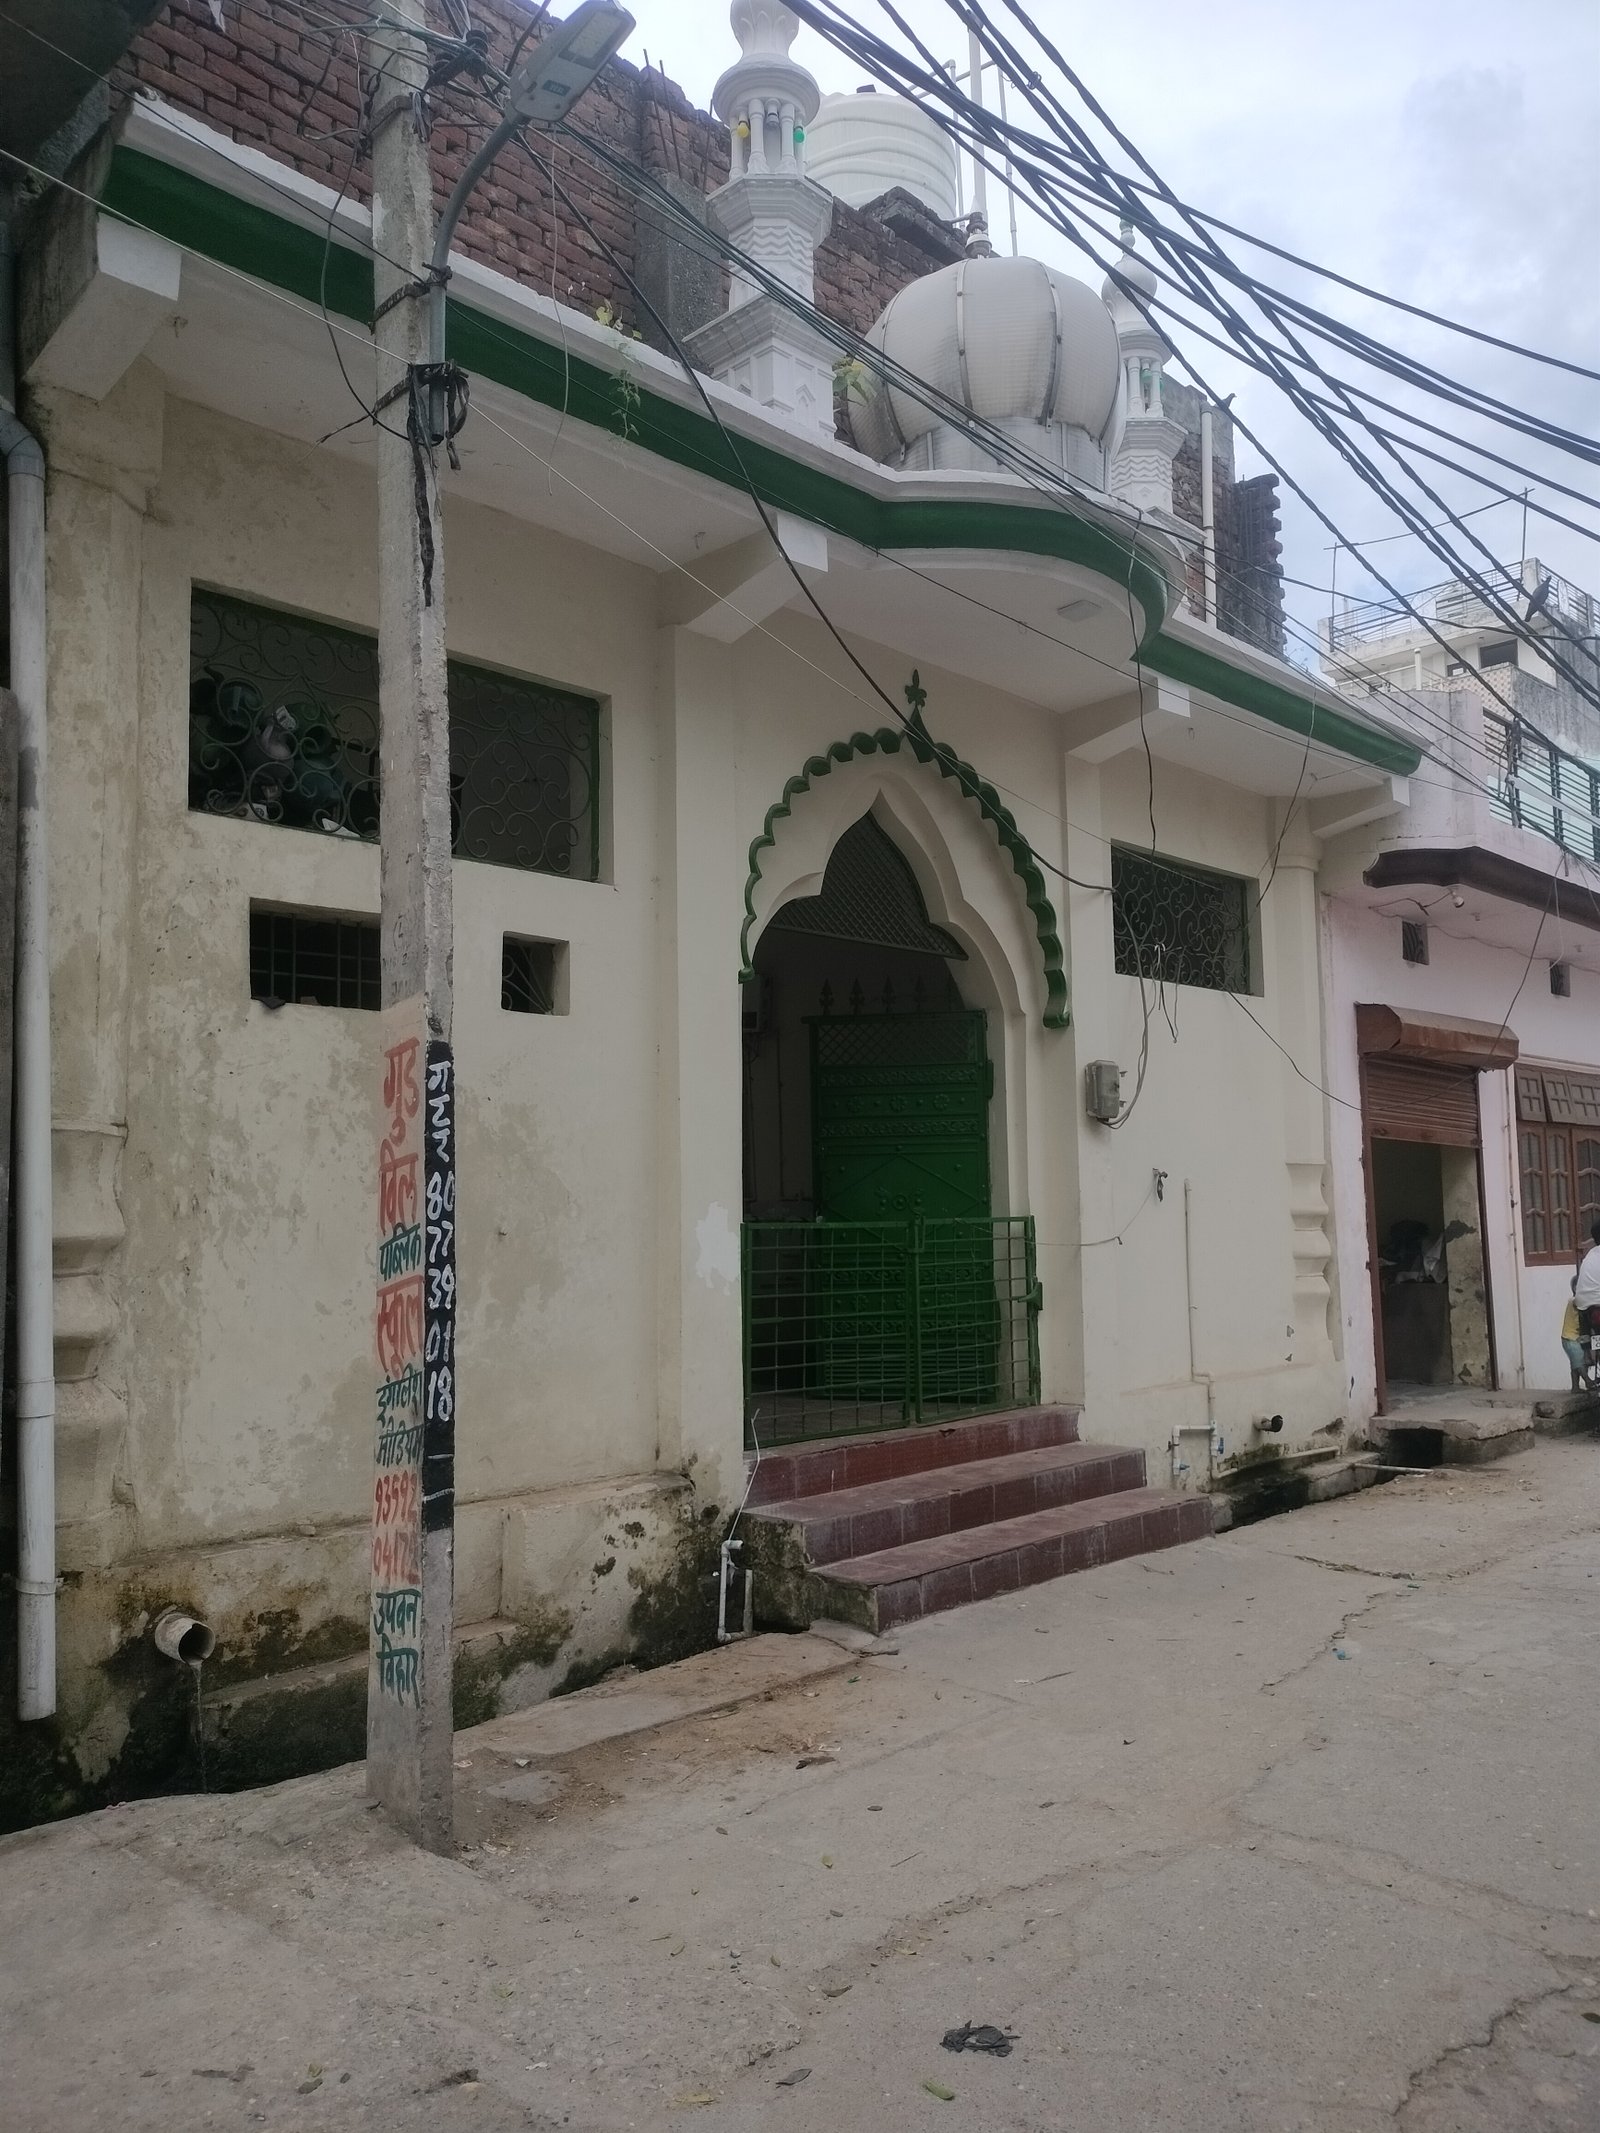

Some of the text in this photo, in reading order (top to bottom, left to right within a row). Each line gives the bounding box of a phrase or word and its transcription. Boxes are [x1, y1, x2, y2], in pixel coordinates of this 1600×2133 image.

[384, 1036, 420, 1147] गुड
[379, 1138, 419, 1237] विल
[374, 1588, 422, 1639] उपवन
[376, 1632, 421, 1710] विहार
